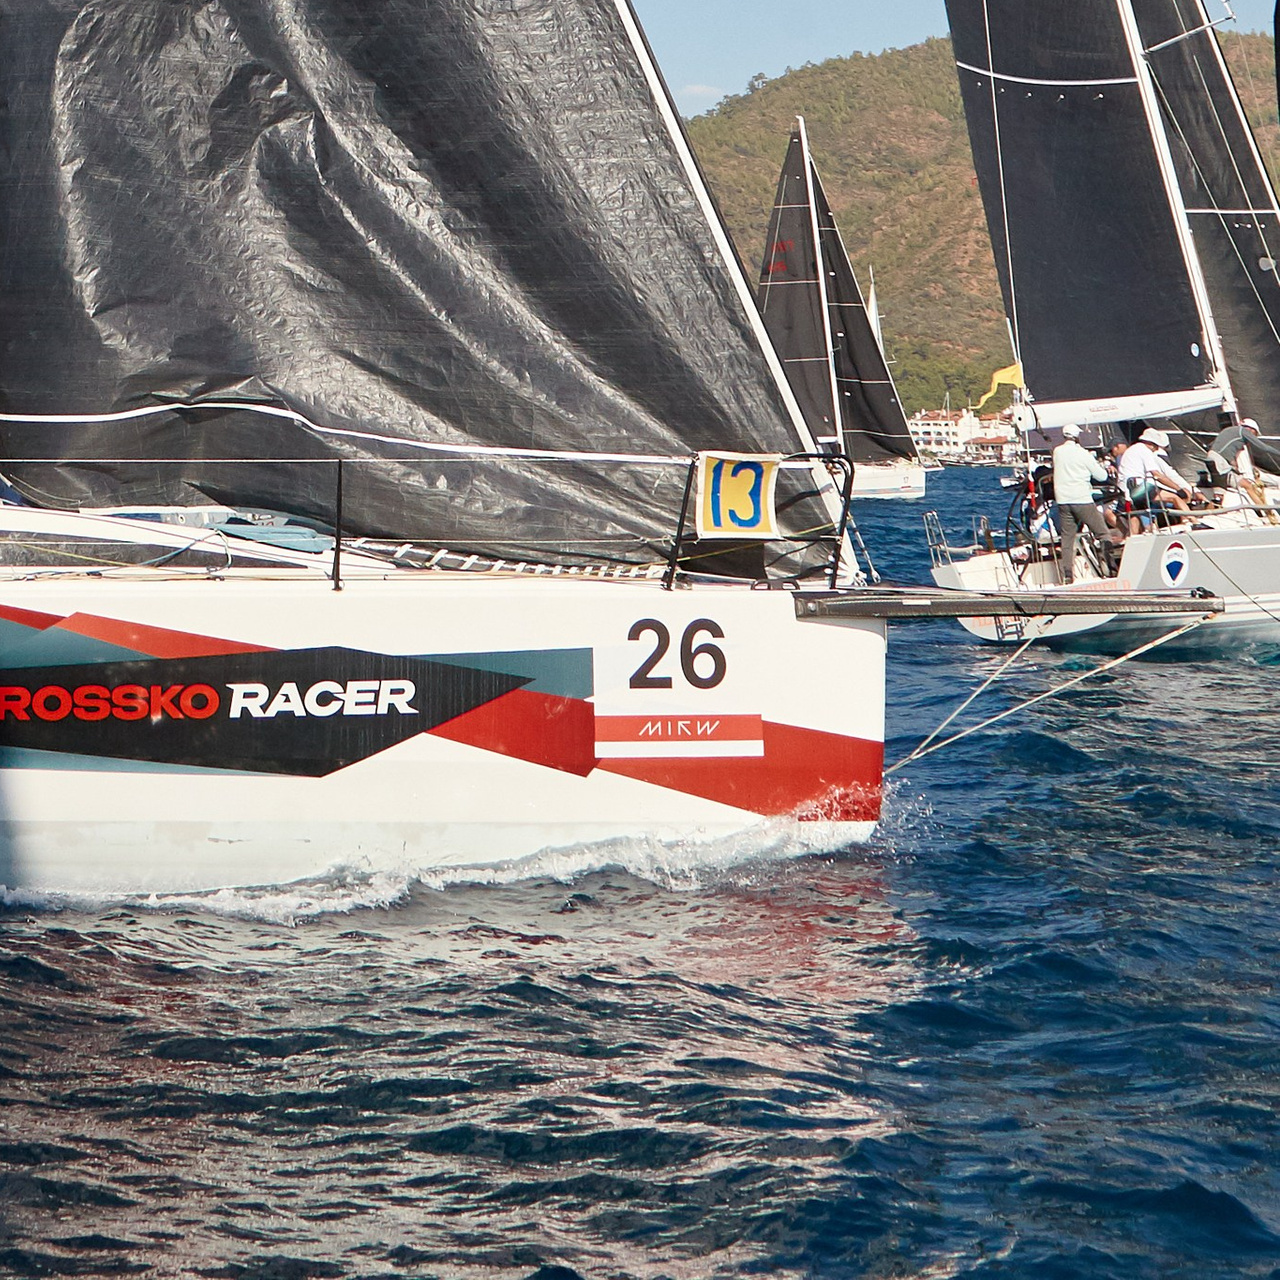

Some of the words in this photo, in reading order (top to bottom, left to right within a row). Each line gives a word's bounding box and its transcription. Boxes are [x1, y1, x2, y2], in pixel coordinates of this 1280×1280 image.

[710, 460, 764, 528] 13
[627, 618, 727, 690] 26
[224, 679, 420, 719] RACER
